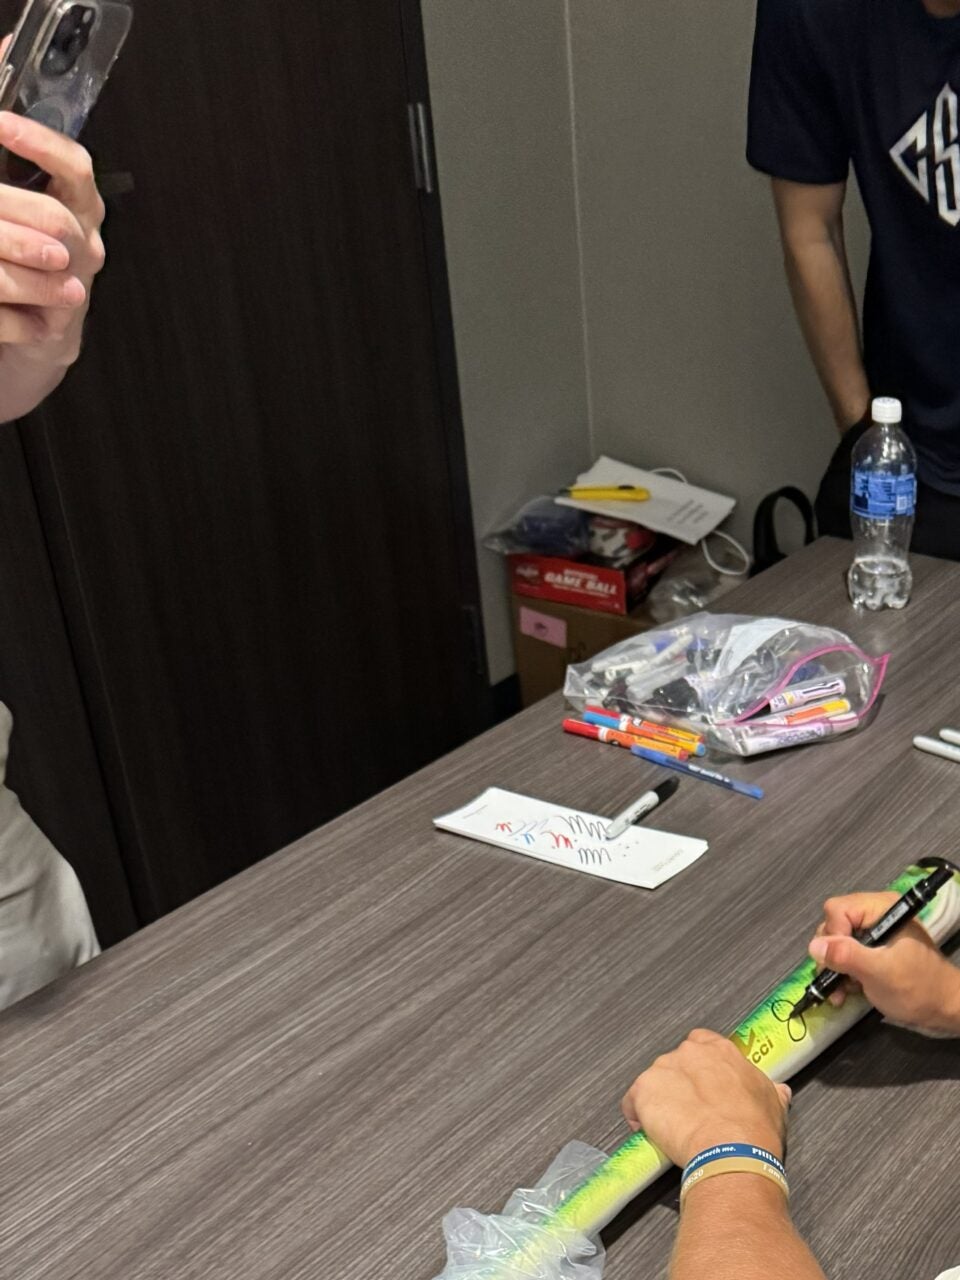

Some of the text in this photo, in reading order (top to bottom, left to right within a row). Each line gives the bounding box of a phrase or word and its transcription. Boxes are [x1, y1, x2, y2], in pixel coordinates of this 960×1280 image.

[543, 571, 581, 589] GAME
[585, 581, 617, 595] BALL
[748, 1038, 774, 1064] cci
